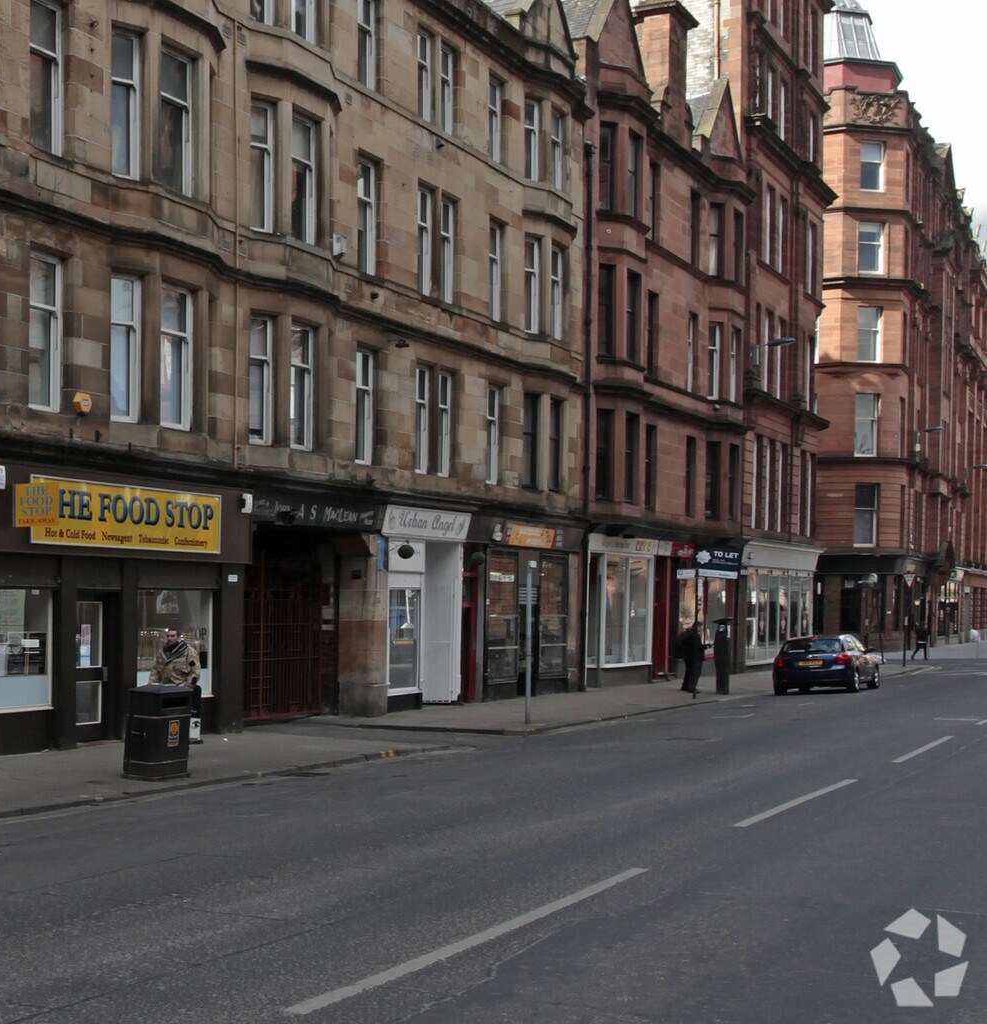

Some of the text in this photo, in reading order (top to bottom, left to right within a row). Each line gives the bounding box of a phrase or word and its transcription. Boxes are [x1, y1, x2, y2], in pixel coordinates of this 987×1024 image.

[25, 485, 48, 496] THE
[20, 496, 53, 507] FOOD
[21, 506, 52, 517] STOP
[59, 488, 214, 530] HE FOOD STOP
[399, 510, 457, 536] Urban Angel
[44, 527, 58, 537] Hot
[65, 529, 80, 540] Cold
[81, 530, 96, 541] Food
[101, 531, 133, 545] Newsagent
[138, 534, 170, 545] Tobacconist
[174, 536, 208, 549] Confectionery
[713, 550, 724, 558] TO
